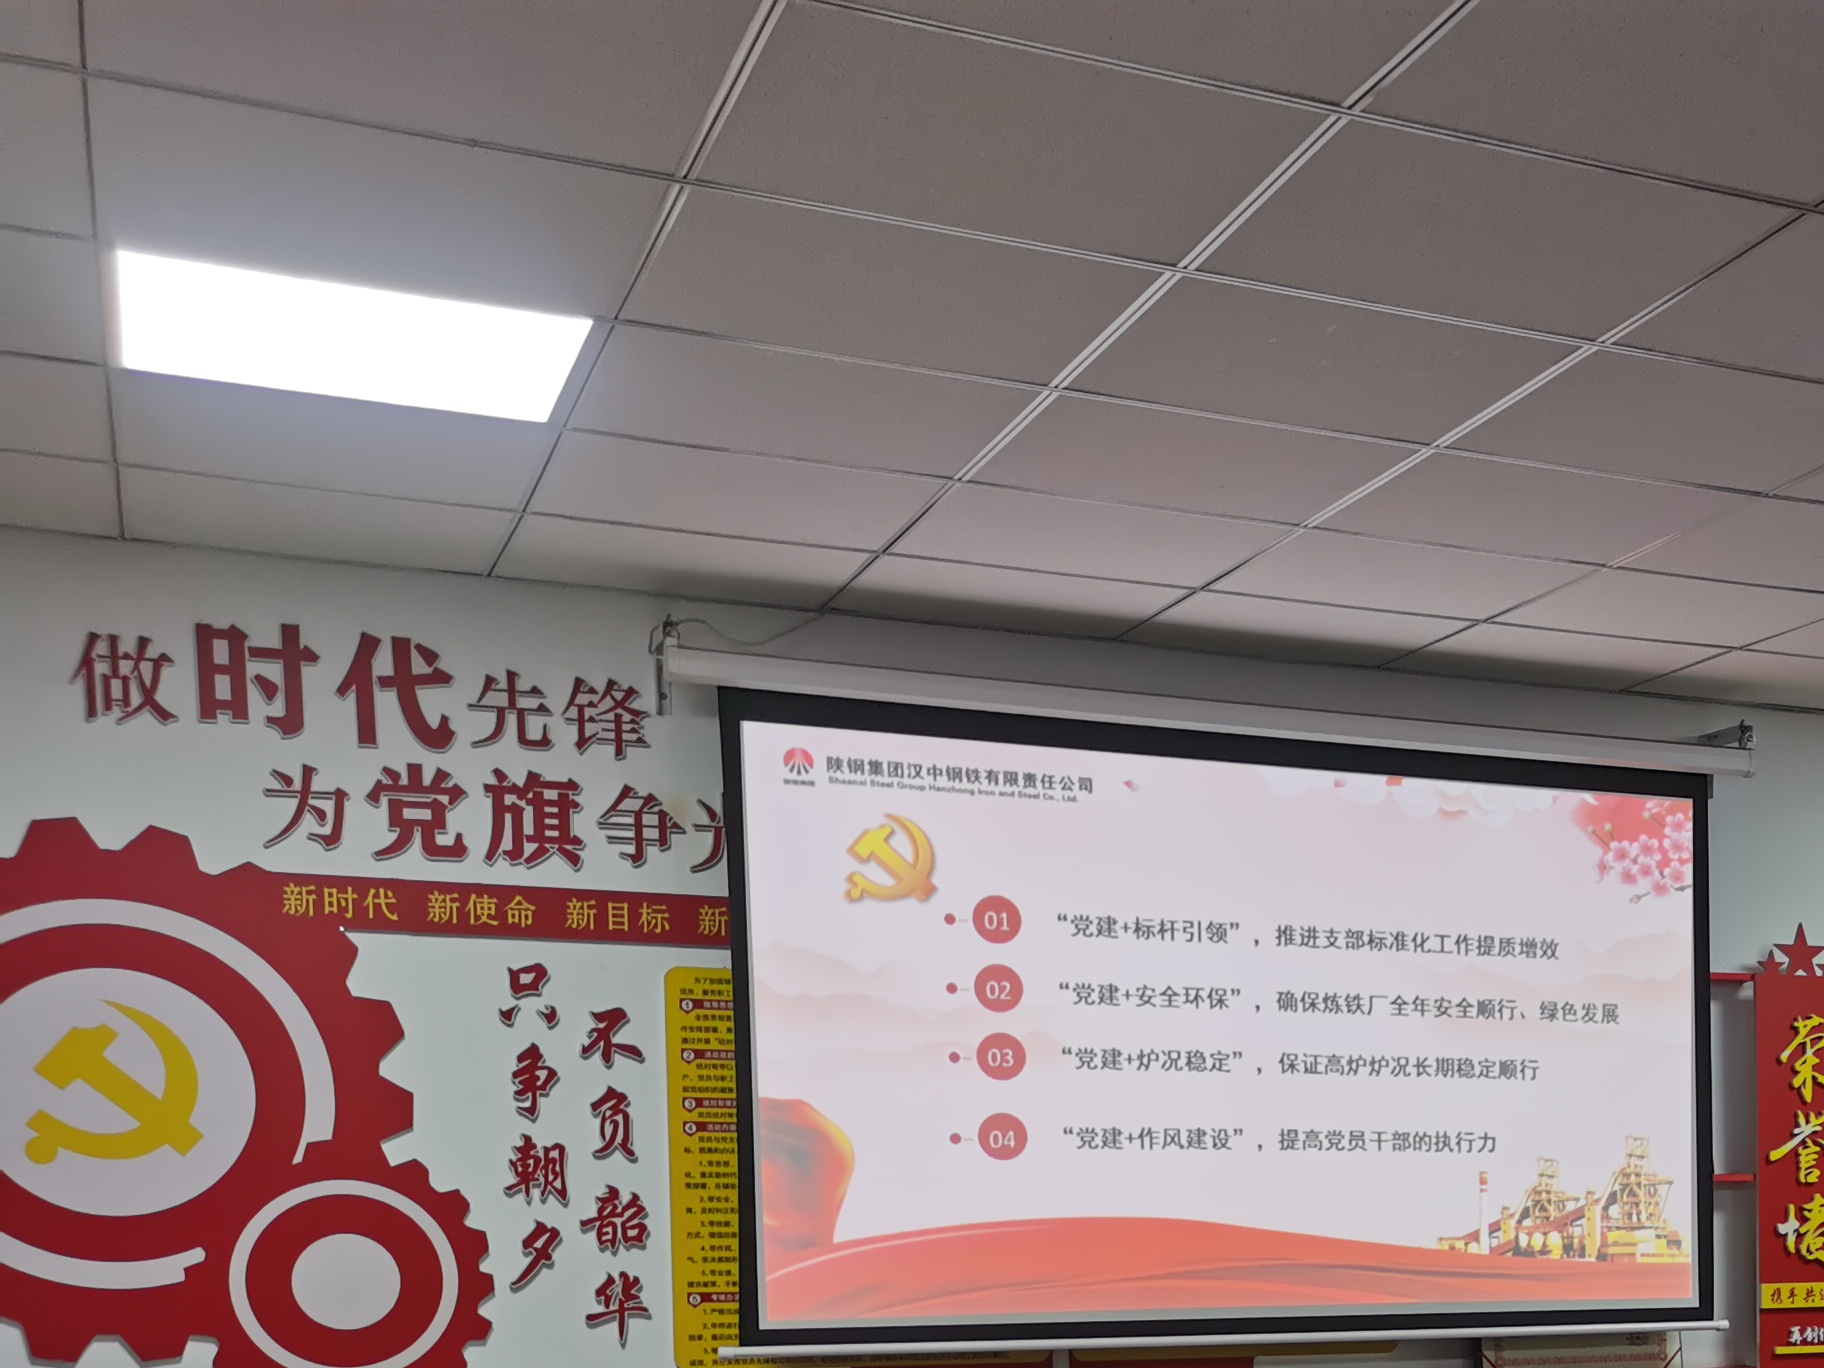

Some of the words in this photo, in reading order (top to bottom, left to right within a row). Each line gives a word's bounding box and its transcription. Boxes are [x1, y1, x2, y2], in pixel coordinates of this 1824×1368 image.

[72, 621, 652, 760] 做时代先锋
[826, 755, 1094, 794] 陕钢集团汉中钢铁有限责任公司
[869, 778, 895, 789] Steel
[897, 780, 926, 792] Group
[998, 789, 1016, 799] and
[1017, 790, 1041, 801] Steel
[282, 883, 400, 921] 新时代
[426, 890, 537, 929] 新使命
[565, 897, 670, 934] 新目标
[984, 909, 1011, 932] 01
[985, 979, 1012, 1001] 02
[987, 1047, 1015, 1069] 03
[500, 962, 570, 1291] 只争朝夕
[989, 1128, 1016, 1150] 04
[580, 1007, 652, 1347] 不负韶华
